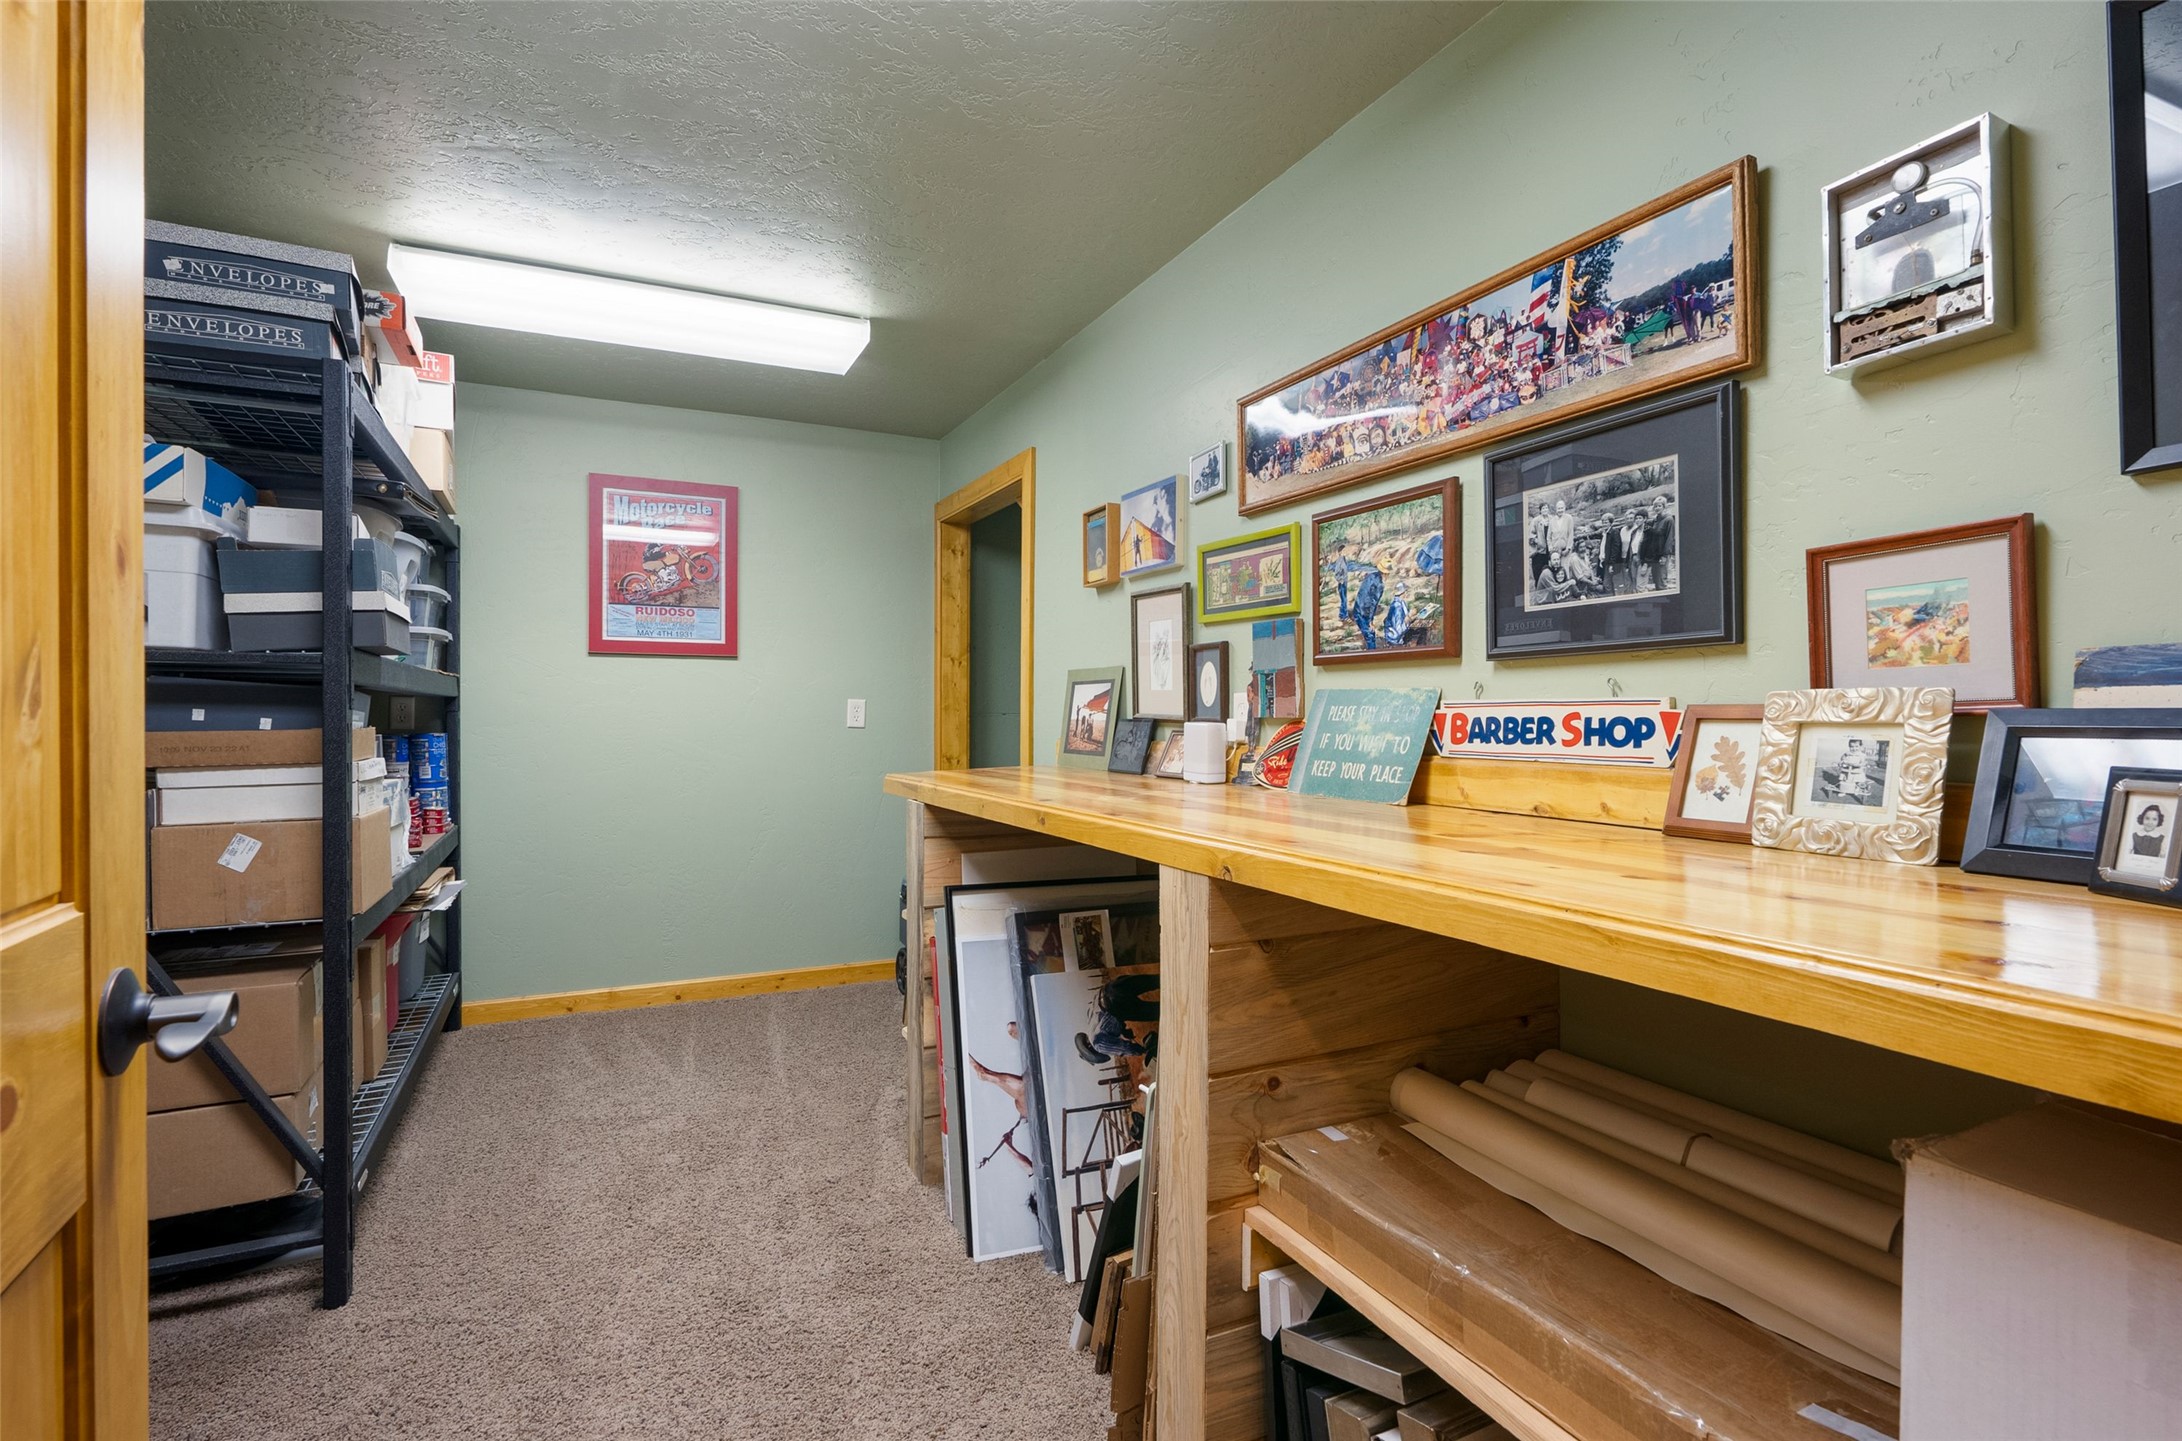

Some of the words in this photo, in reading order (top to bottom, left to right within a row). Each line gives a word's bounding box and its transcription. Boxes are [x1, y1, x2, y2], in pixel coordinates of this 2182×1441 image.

[148, 312, 303, 344] ENVELOPES
[614, 495, 713, 525] Motorcycle
[641, 515, 686, 529] Race
[635, 607, 695, 617] RUIDOSO
[1328, 705, 1355, 722] PLEASE
[1359, 705, 1379, 722] STAY
[1450, 712, 1556, 747] BARBER
[1561, 711, 1656, 749] SHOP
[1319, 732, 1331, 749] IF
[1333, 734, 1354, 751] YOU
[1393, 735, 1411, 755] TO
[1311, 760, 1336, 777] KEEP
[1339, 762, 1365, 781] YOUR
[1369, 764, 1404, 784] PLACE
